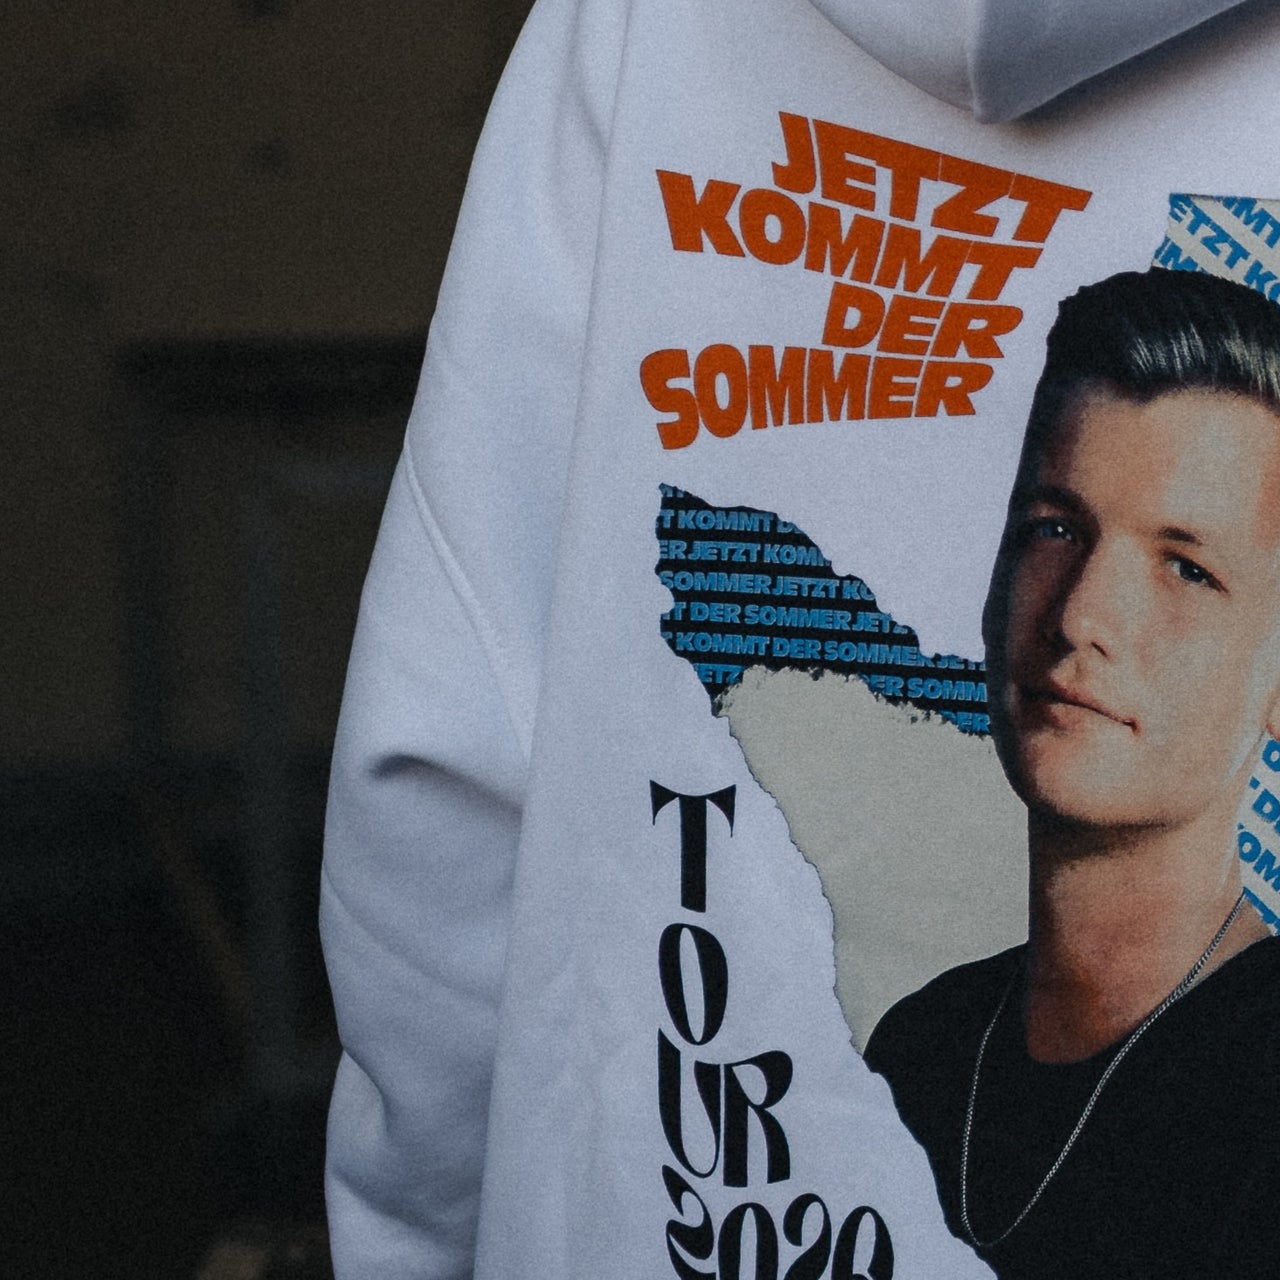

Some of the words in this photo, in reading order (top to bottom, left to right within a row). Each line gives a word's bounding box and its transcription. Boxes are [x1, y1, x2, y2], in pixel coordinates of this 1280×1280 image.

[771, 111, 1092, 243] JETZT
[656, 169, 1043, 301] KOMMT
[822, 281, 1023, 359] DER
[640, 344, 993, 450] SOMMER
[677, 509, 775, 532] KOMMT
[688, 541, 761, 563] JETZT
[660, 571, 772, 594] SOMMER
[772, 576, 839, 598] JETZT
[690, 602, 741, 623] DER
[744, 604, 851, 631] SOMMER
[676, 632, 770, 655] KOMMT
[772, 637, 821, 659] DER
[650, 780, 793, 1187] TOUR
